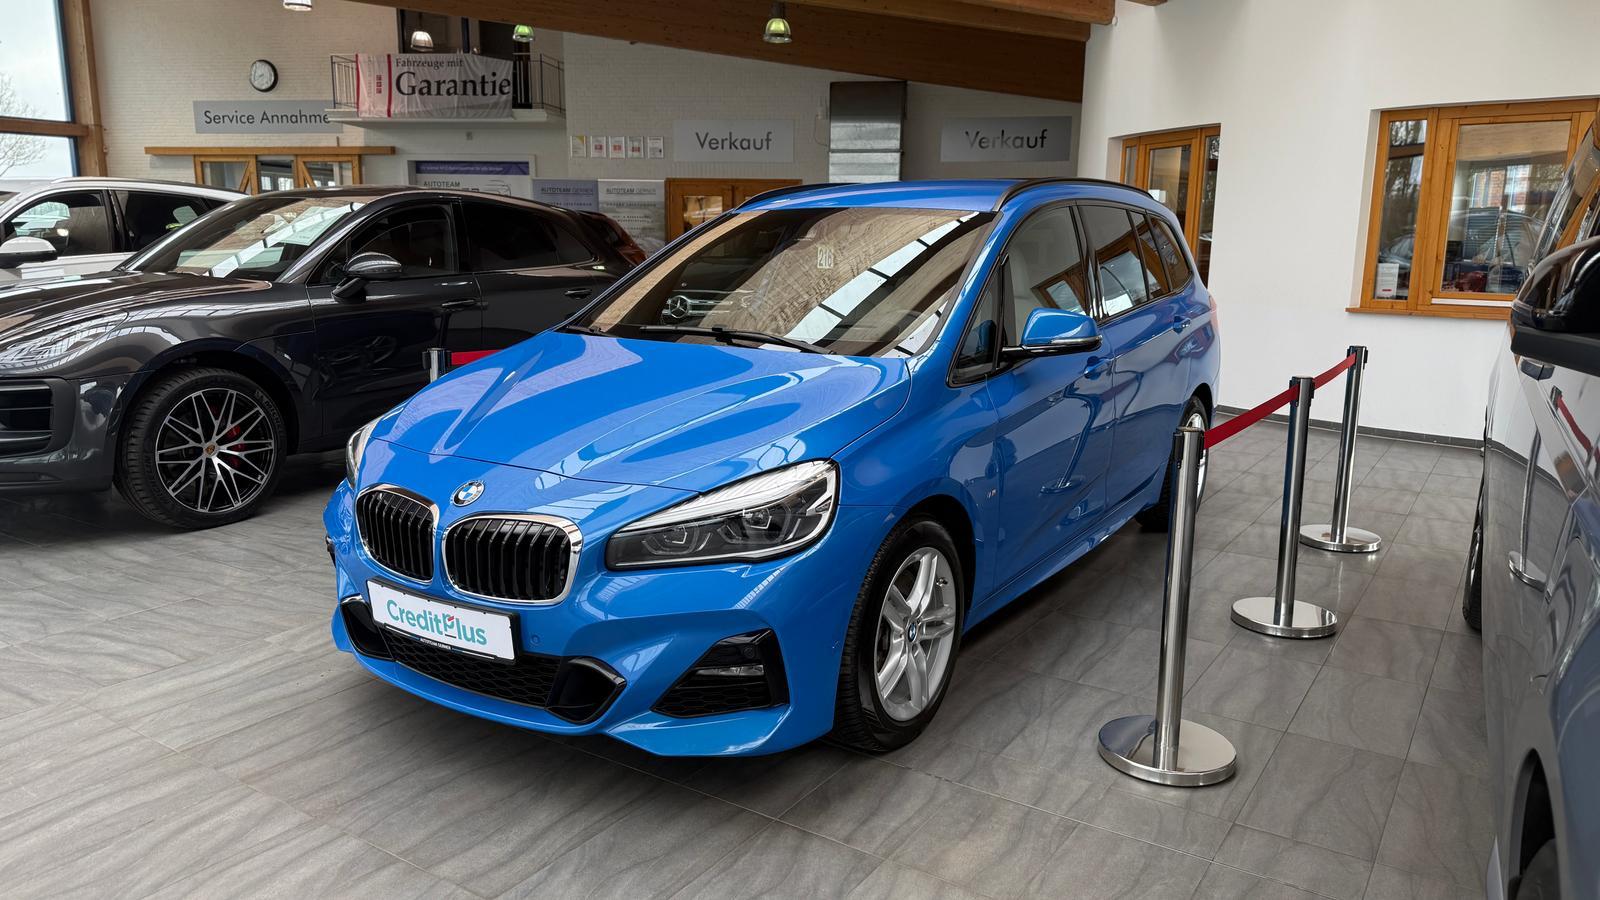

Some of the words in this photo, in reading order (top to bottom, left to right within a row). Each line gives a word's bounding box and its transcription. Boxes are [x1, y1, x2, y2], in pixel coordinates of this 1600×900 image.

[396, 58, 445, 70] Fahrzeuge
[447, 58, 464, 68] mit
[395, 71, 512, 97] Garantie
[204, 110, 255, 125] Service
[260, 109, 331, 125] Annahme
[695, 131, 773, 151] Verkauf
[965, 128, 1048, 149] Verkauf
[423, 180, 461, 188] AUTOTEAM
[386, 599, 488, 646] CreditPlus
